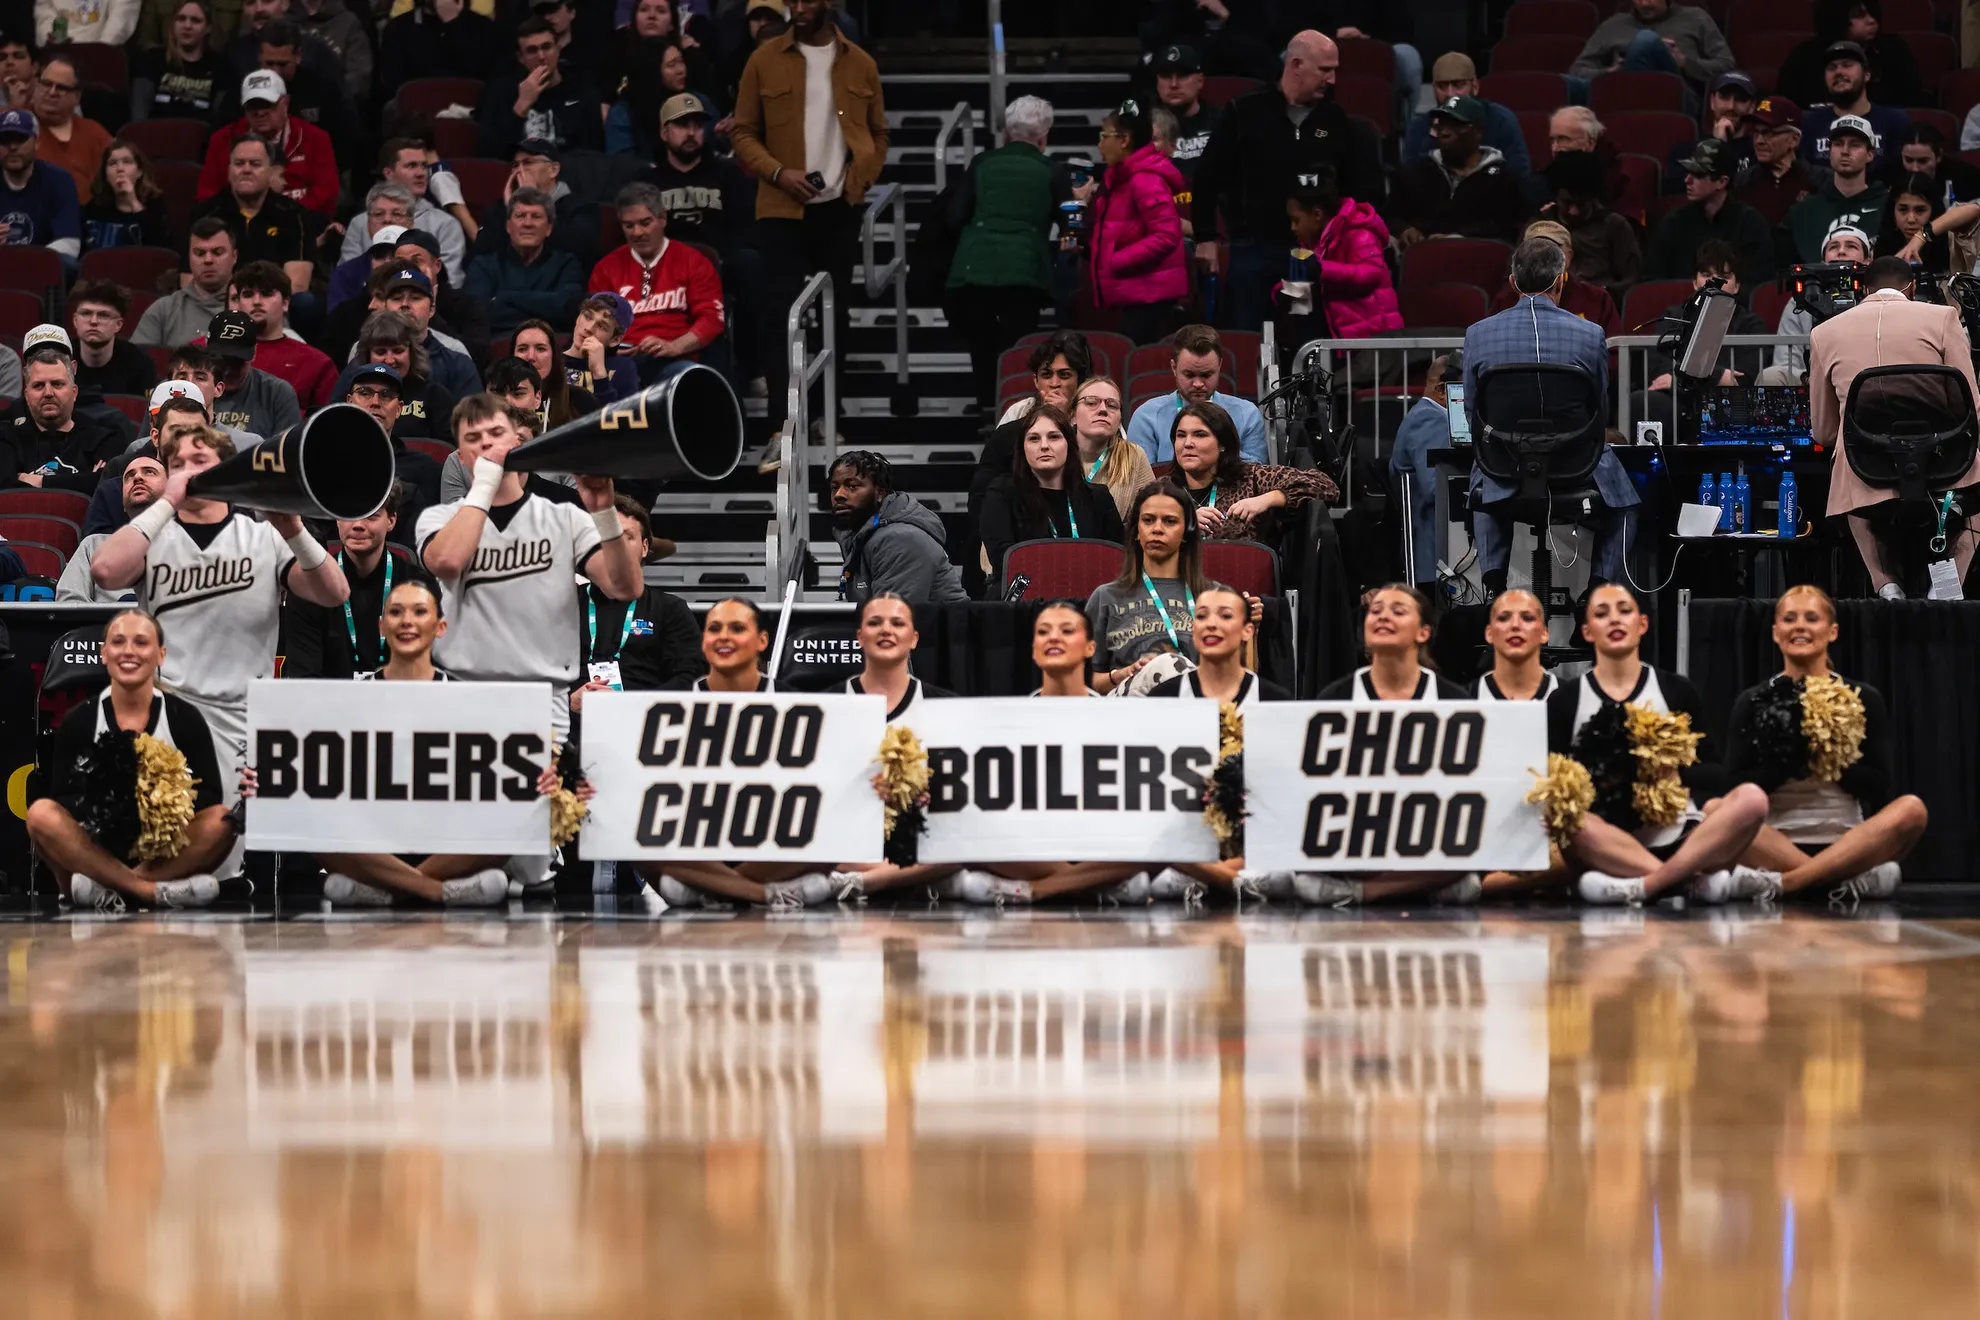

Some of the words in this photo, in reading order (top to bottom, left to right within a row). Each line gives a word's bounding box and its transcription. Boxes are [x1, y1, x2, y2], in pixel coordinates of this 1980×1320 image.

[220, 324, 245, 340] P
[149, 556, 254, 602] Purdue
[467, 537, 553, 574] urdue
[794, 639, 862, 650] UNITED
[794, 653, 863, 664] CENTER
[257, 730, 545, 801] BOILERS
[638, 703, 824, 767] CHOO
[1301, 711, 1485, 776] CHOO
[928, 746, 1212, 814] BOILERS
[636, 783, 822, 848] CHOO
[1302, 792, 1487, 858] CHOO
